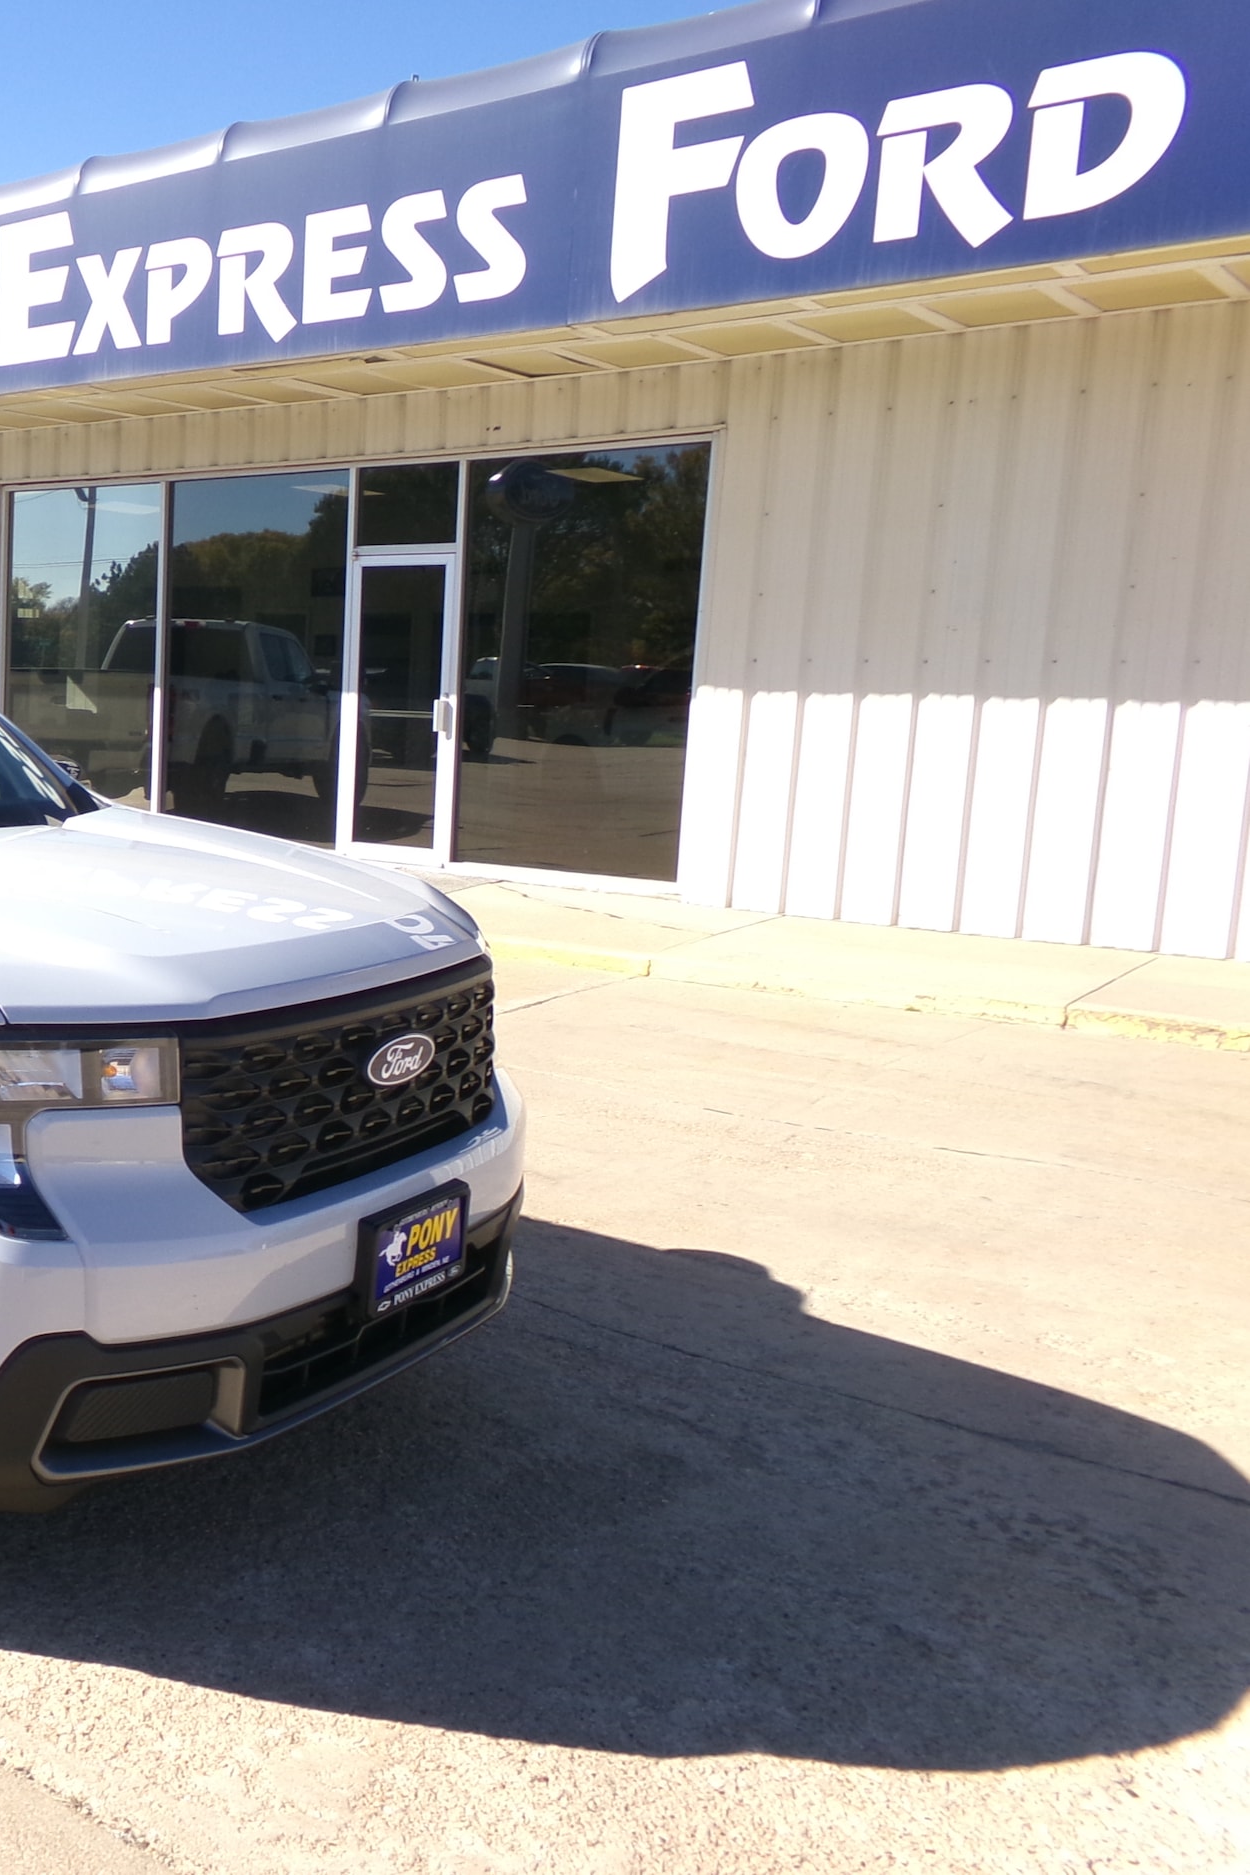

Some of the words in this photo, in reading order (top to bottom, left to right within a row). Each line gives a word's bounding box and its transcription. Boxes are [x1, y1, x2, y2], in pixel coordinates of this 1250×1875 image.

[610, 51, 1186, 302] FORD
[381, 1042, 424, 1079] Ford
[406, 1207, 459, 1257] PONY
[395, 1247, 437, 1277] EXPRESS
[393, 1287, 416, 1305] PONY
[415, 1271, 446, 1296] EXPRESS
